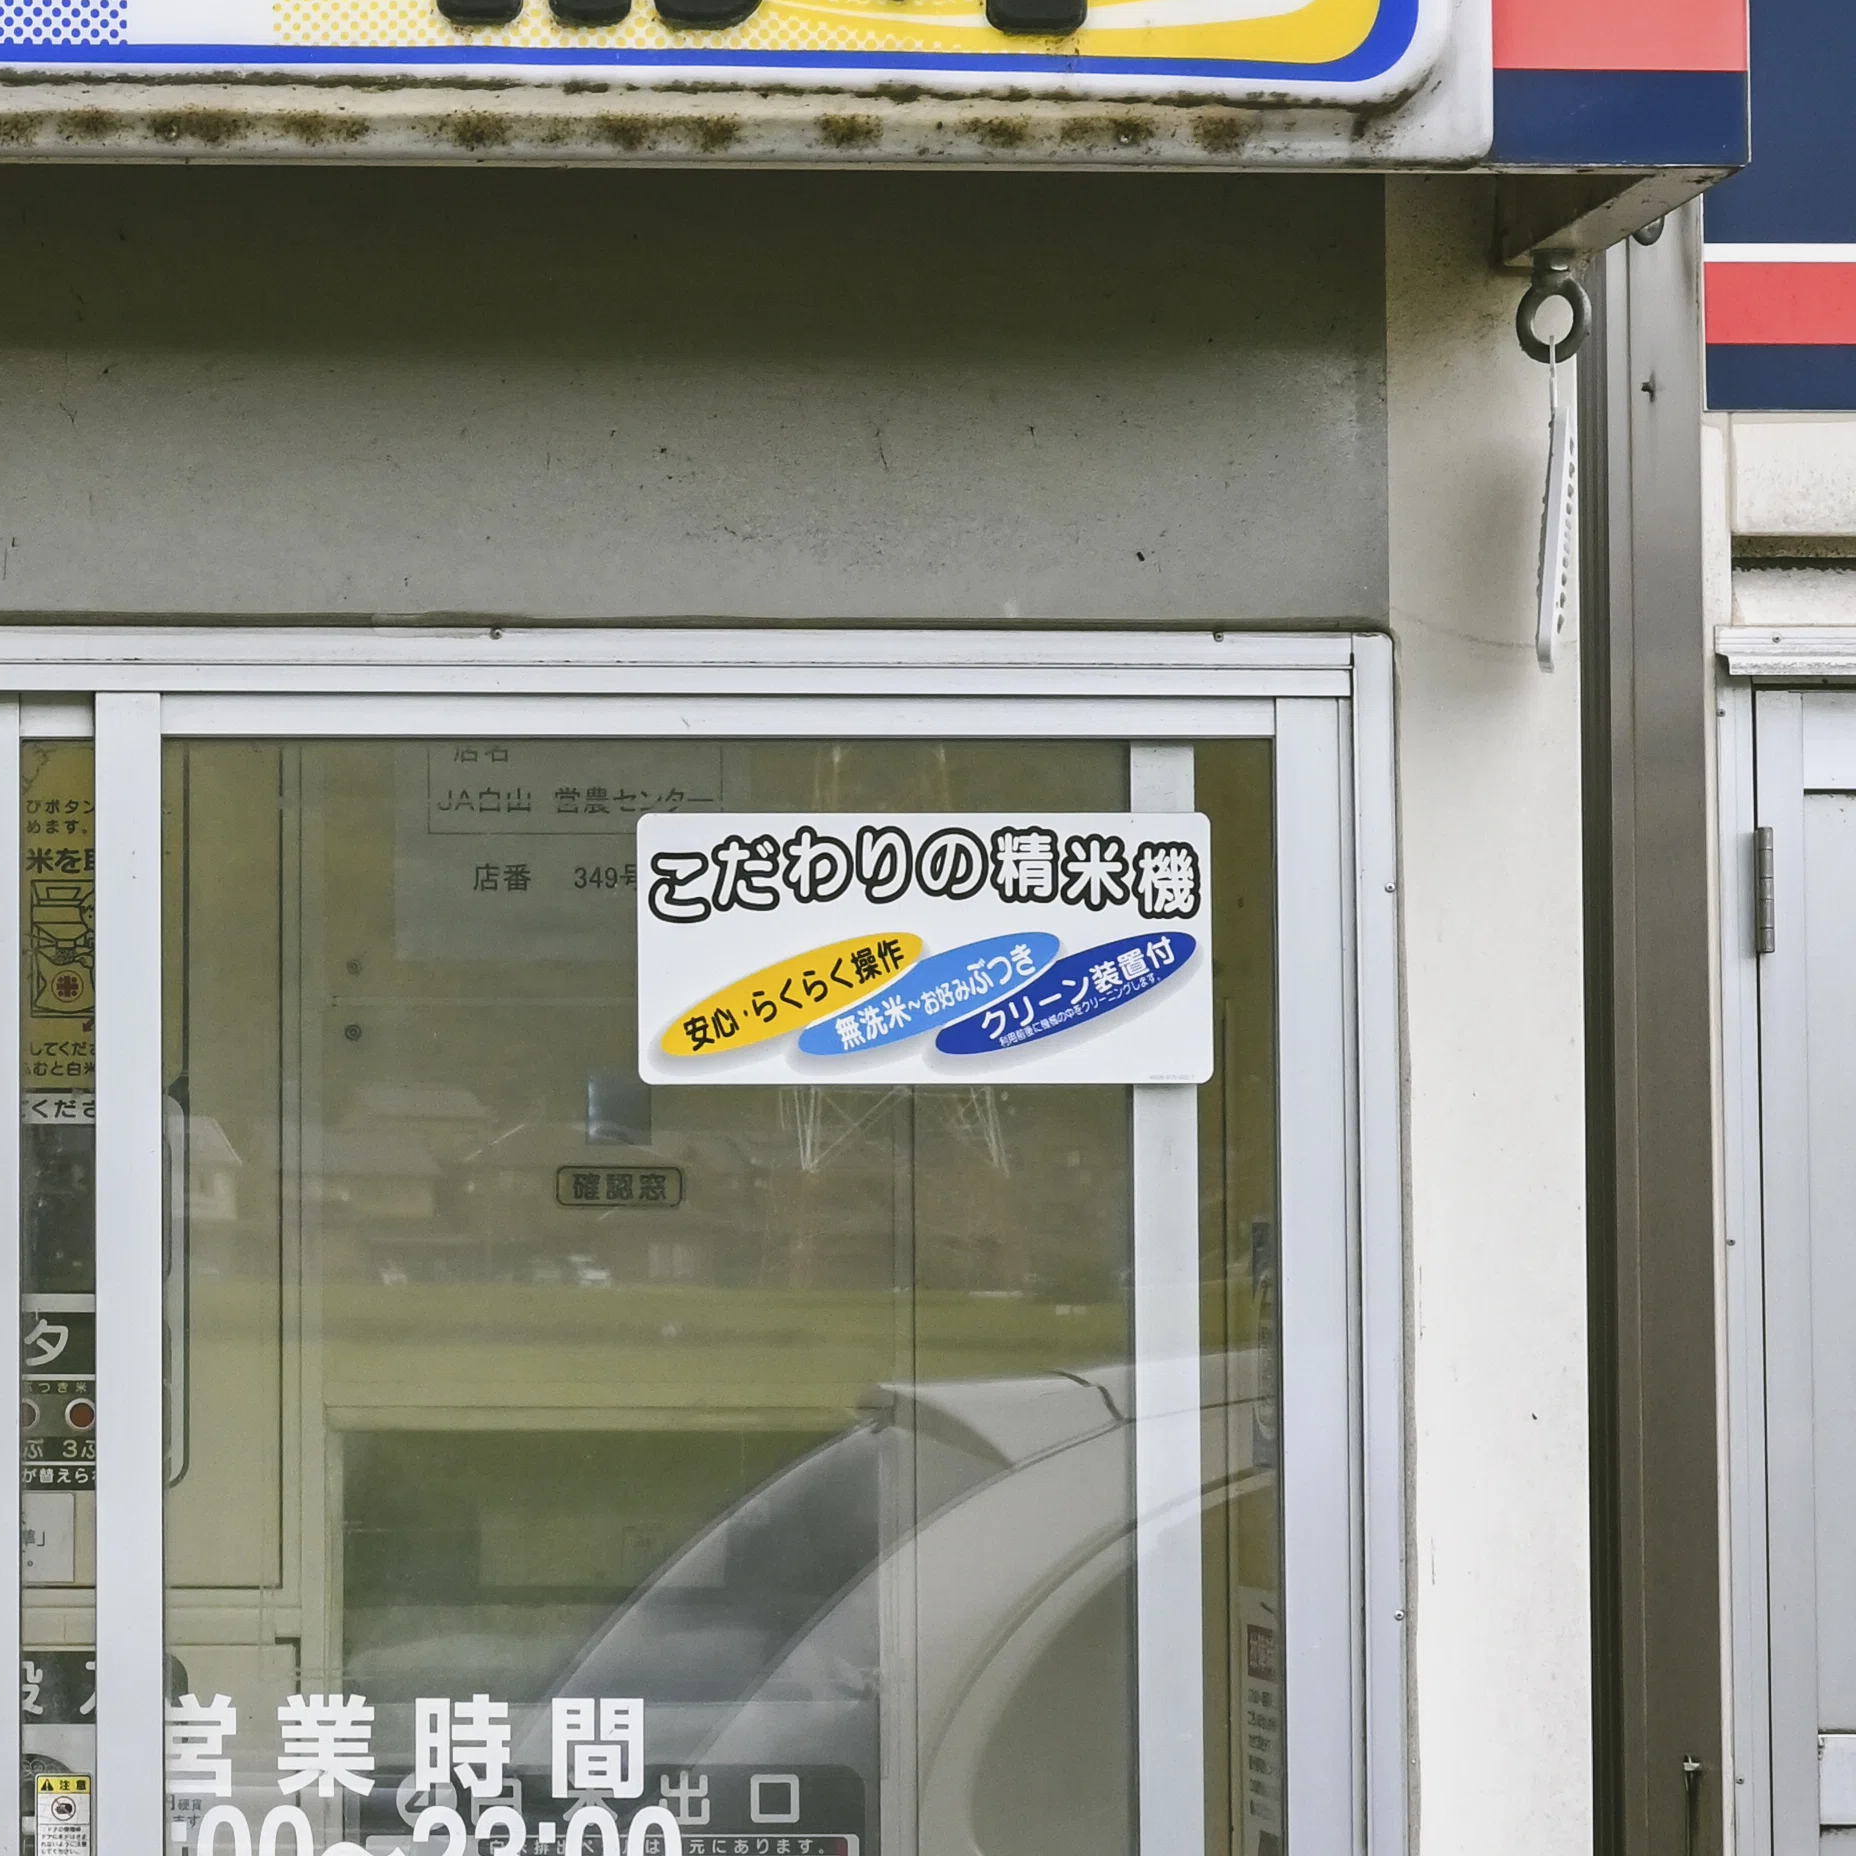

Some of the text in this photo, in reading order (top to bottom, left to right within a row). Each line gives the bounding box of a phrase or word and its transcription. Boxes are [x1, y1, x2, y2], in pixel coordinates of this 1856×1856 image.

[473, 863, 532, 892] 店番
[648, 825, 1202, 924] こだわりの精米機
[682, 938, 907, 1052] 安心・らくらく操作
[980, 934, 1177, 1041] クリーン装置付
[59, 1780, 88, 1791] 注意
[165, 1693, 646, 1798] 営業時間
